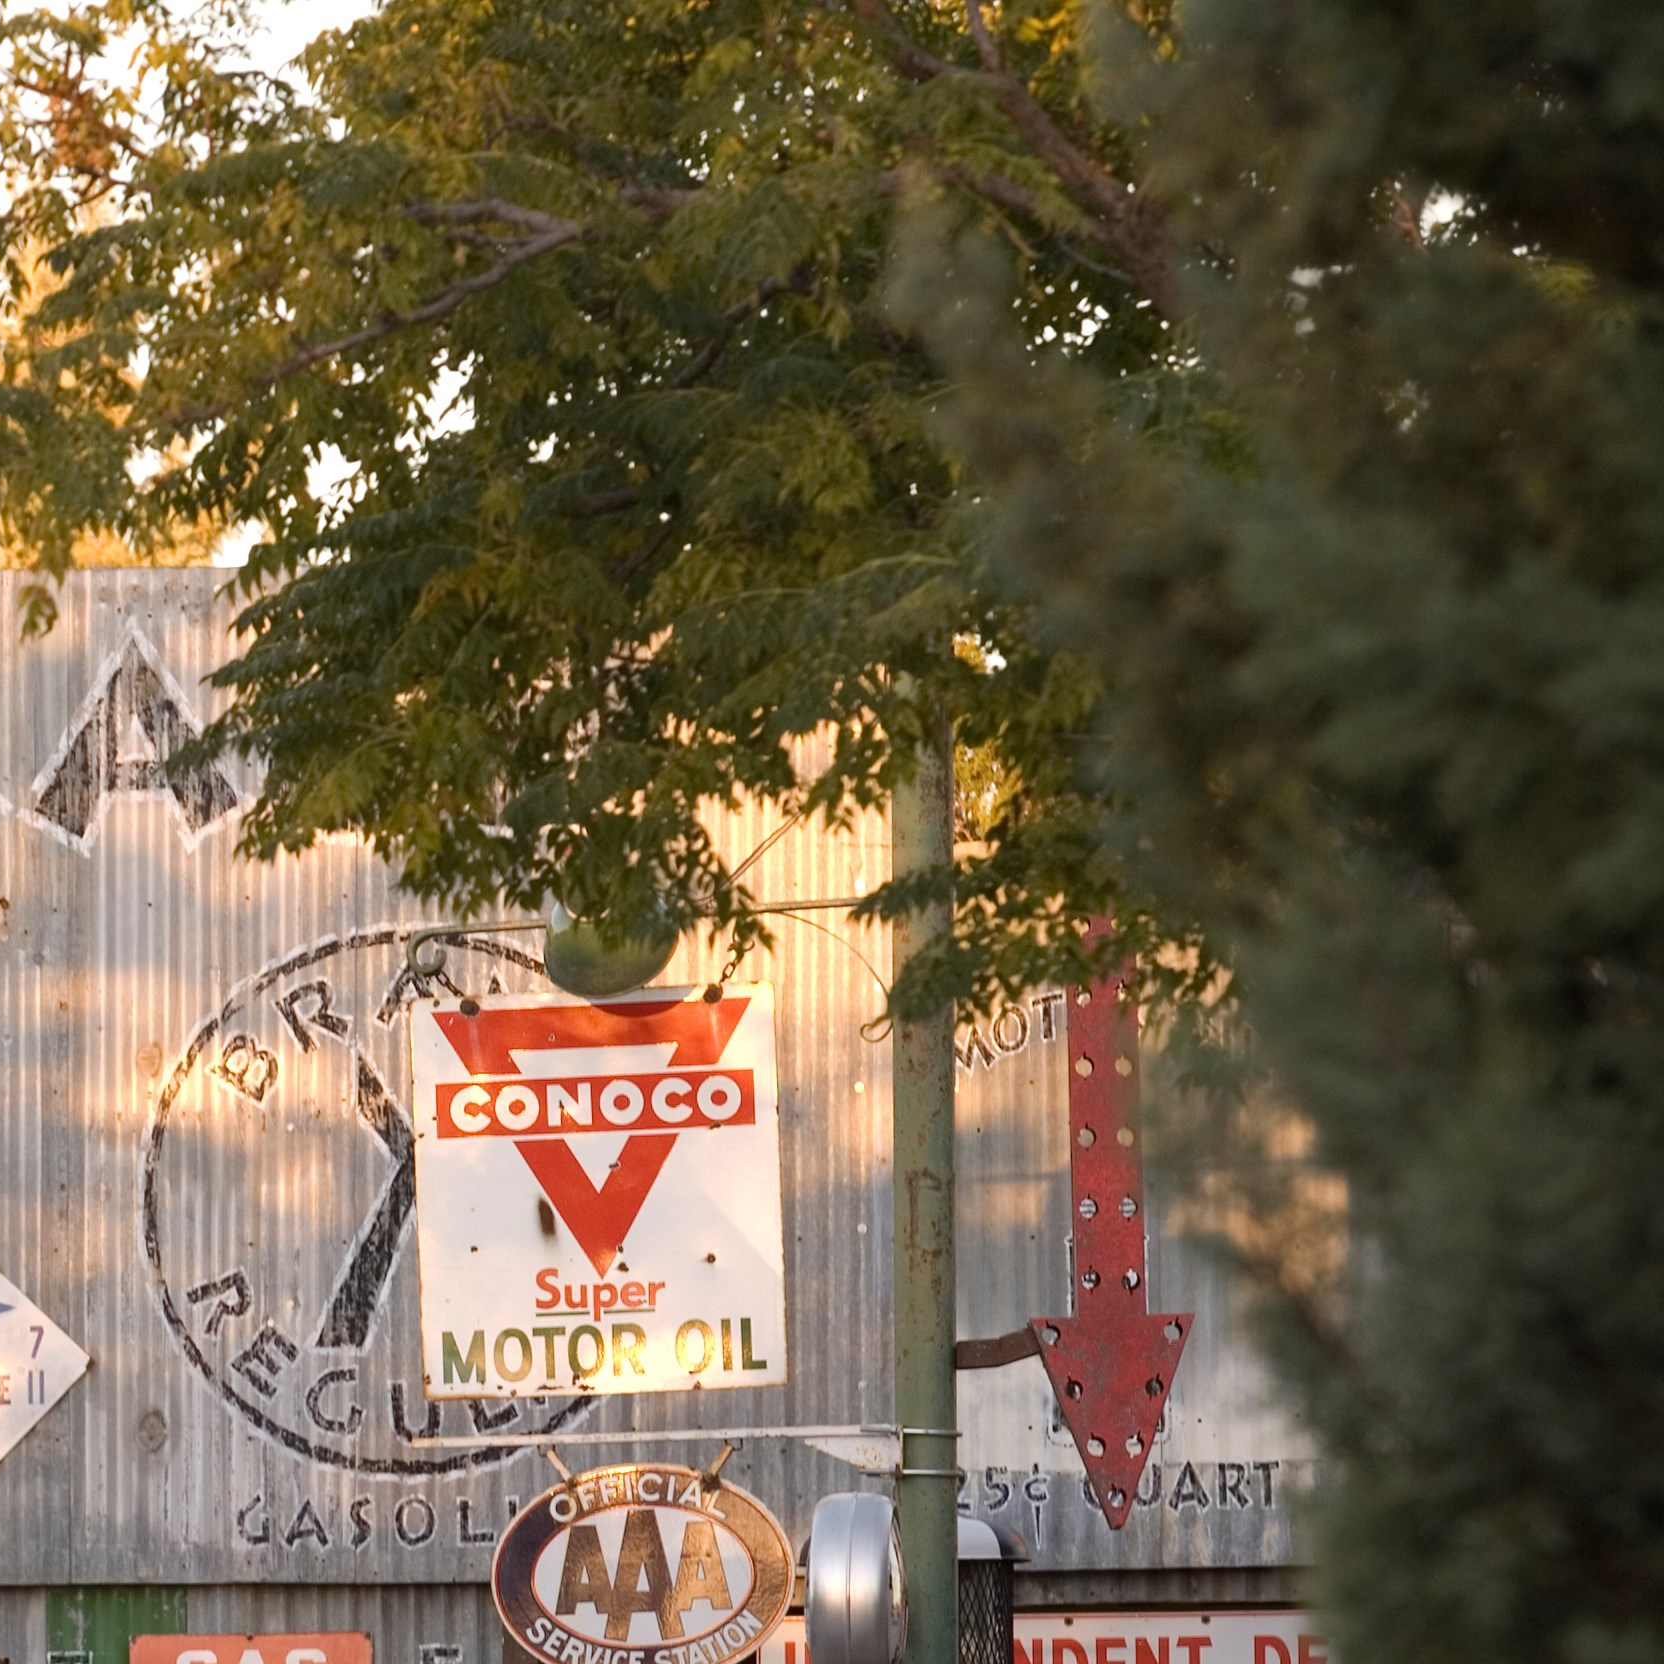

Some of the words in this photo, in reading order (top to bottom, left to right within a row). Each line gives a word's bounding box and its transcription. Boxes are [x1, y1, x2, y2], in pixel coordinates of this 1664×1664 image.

[450, 1075, 741, 1133] CONOCO
[535, 1268, 665, 1321] Super
[30, 1325, 44, 1359] 7
[442, 1322, 647, 1384] MOTOR
[675, 1317, 768, 1374] OIL
[549, 1473, 727, 1523] OFFICIAL
[556, 1509, 733, 1641] AAA
